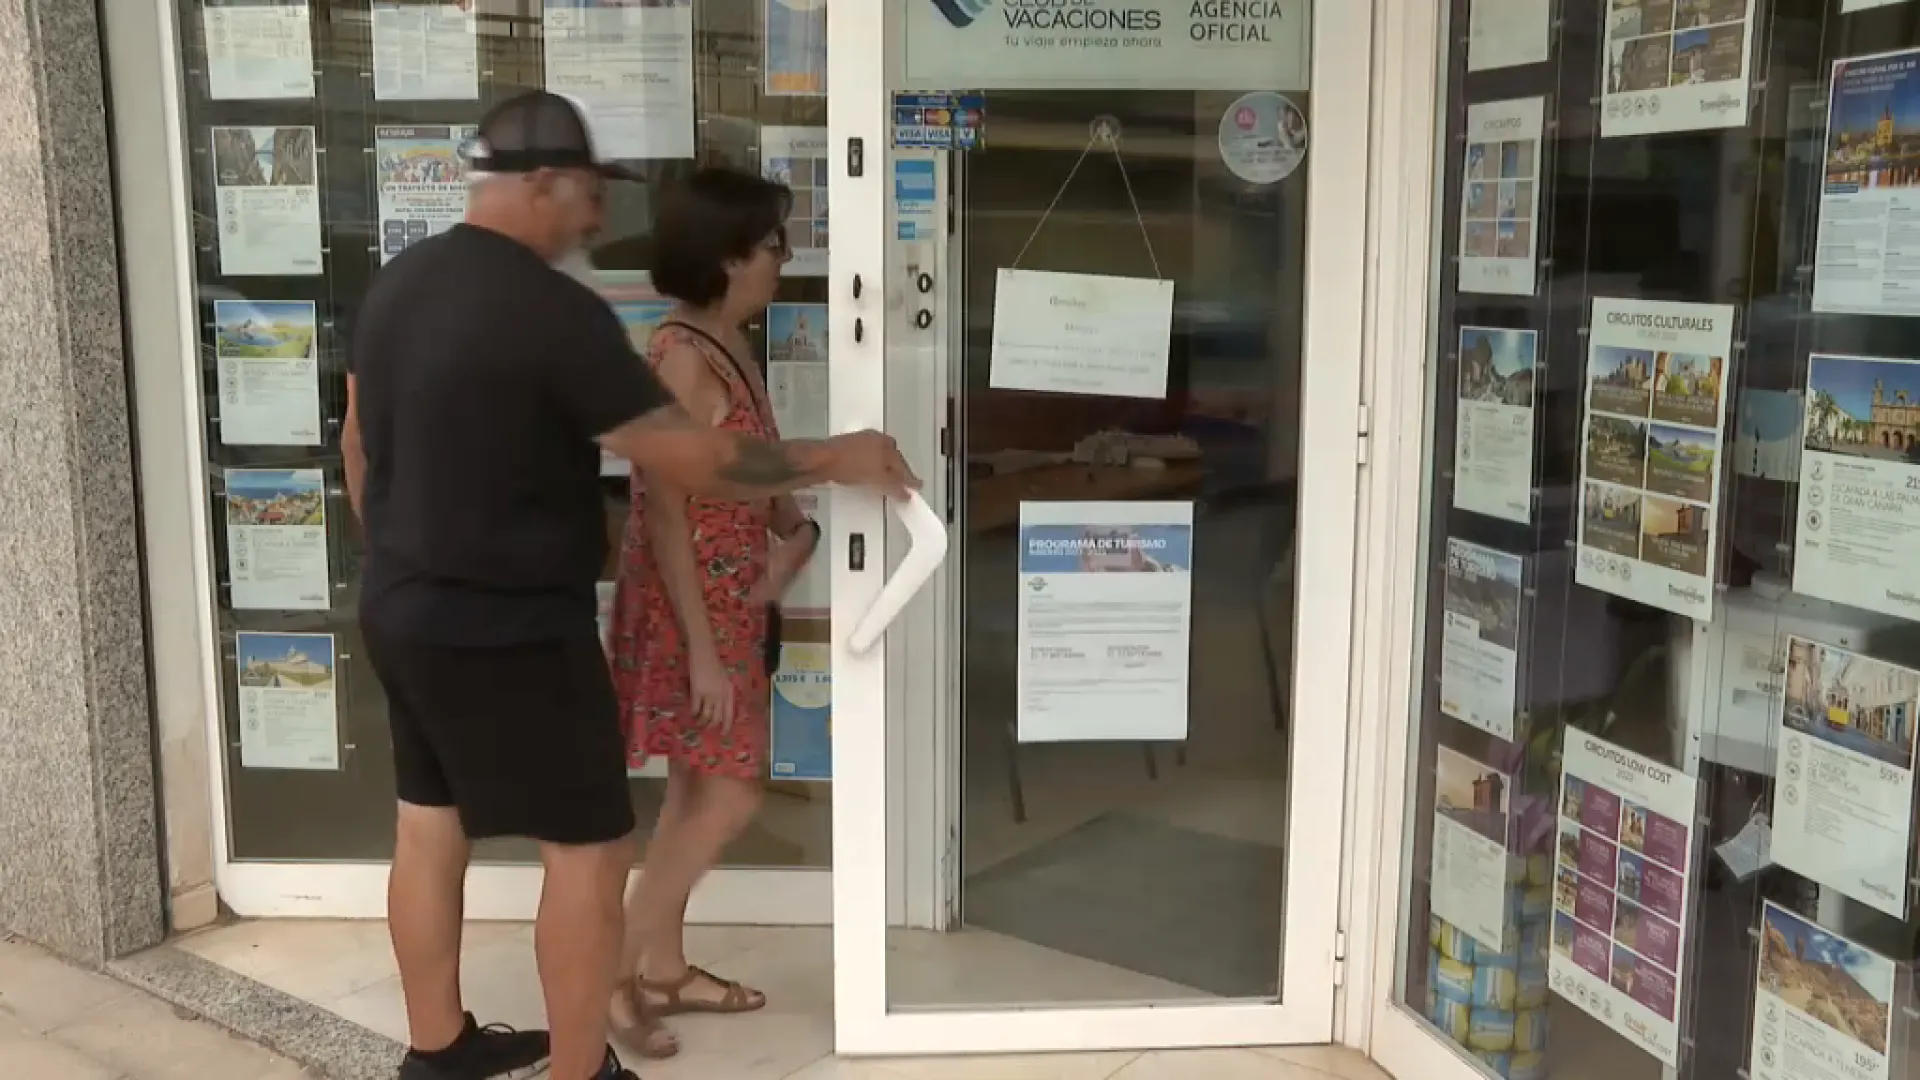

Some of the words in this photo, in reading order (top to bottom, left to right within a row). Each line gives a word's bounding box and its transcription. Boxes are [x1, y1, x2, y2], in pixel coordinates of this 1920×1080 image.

[1189, 0, 1282, 18] AGENCIA
[1003, 8, 1162, 30] VACACIONES
[1024, 35, 1055, 49] viaje
[1060, 36, 1119, 49] empieza
[1122, 36, 1163, 48] ahora
[1190, 23, 1272, 42] OFICIAL
[1606, 311, 1653, 328] CIRCUITOS
[1654, 314, 1714, 333] CULTURALES
[1028, 538, 1096, 550] PROGRAMA
[1098, 539, 1112, 549] DE
[1112, 539, 1167, 549] TURISMO
[1584, 739, 1626, 767] CIRCUITOS
[1627, 756, 1646, 774] LOW
[1647, 766, 1672, 785] COST
